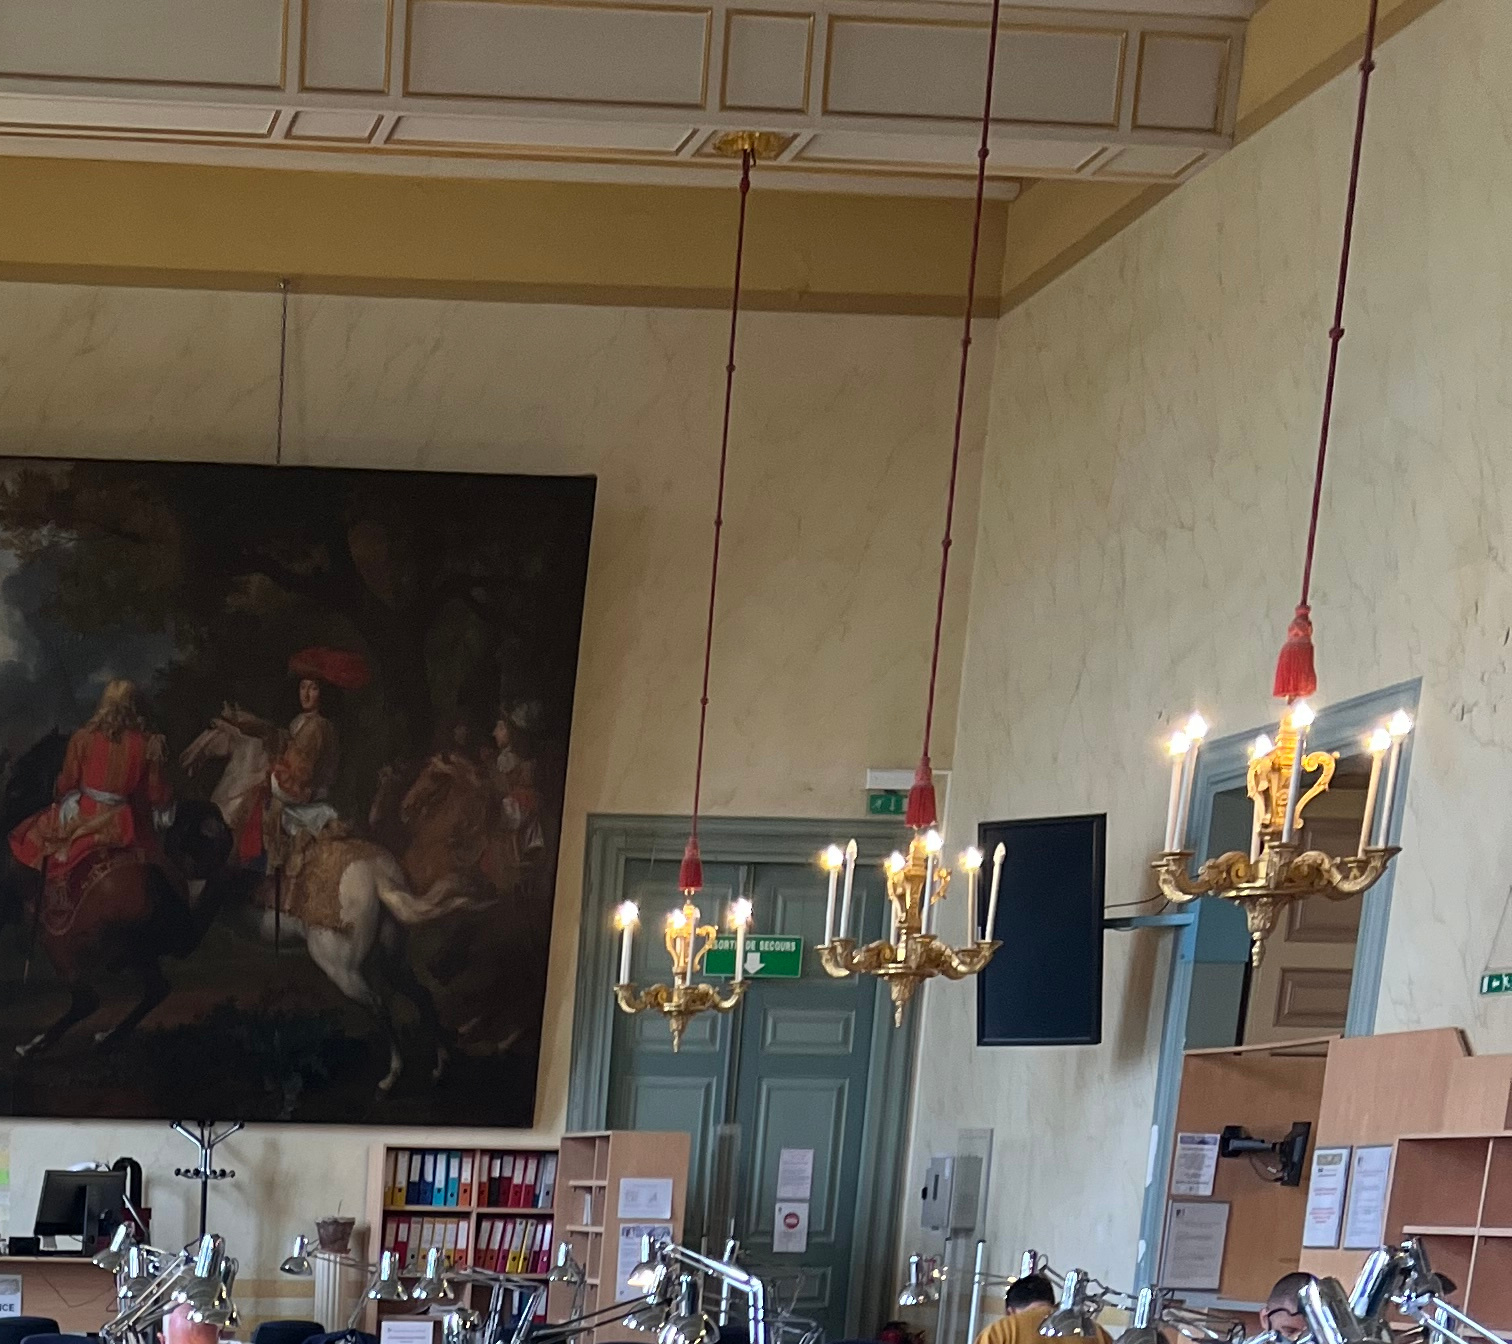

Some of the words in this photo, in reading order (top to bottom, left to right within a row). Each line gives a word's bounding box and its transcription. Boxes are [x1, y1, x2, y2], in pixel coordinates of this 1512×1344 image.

[714, 940, 742, 950] SORTI
[745, 940, 757, 950] DE
[759, 941, 796, 952] SECOURS
